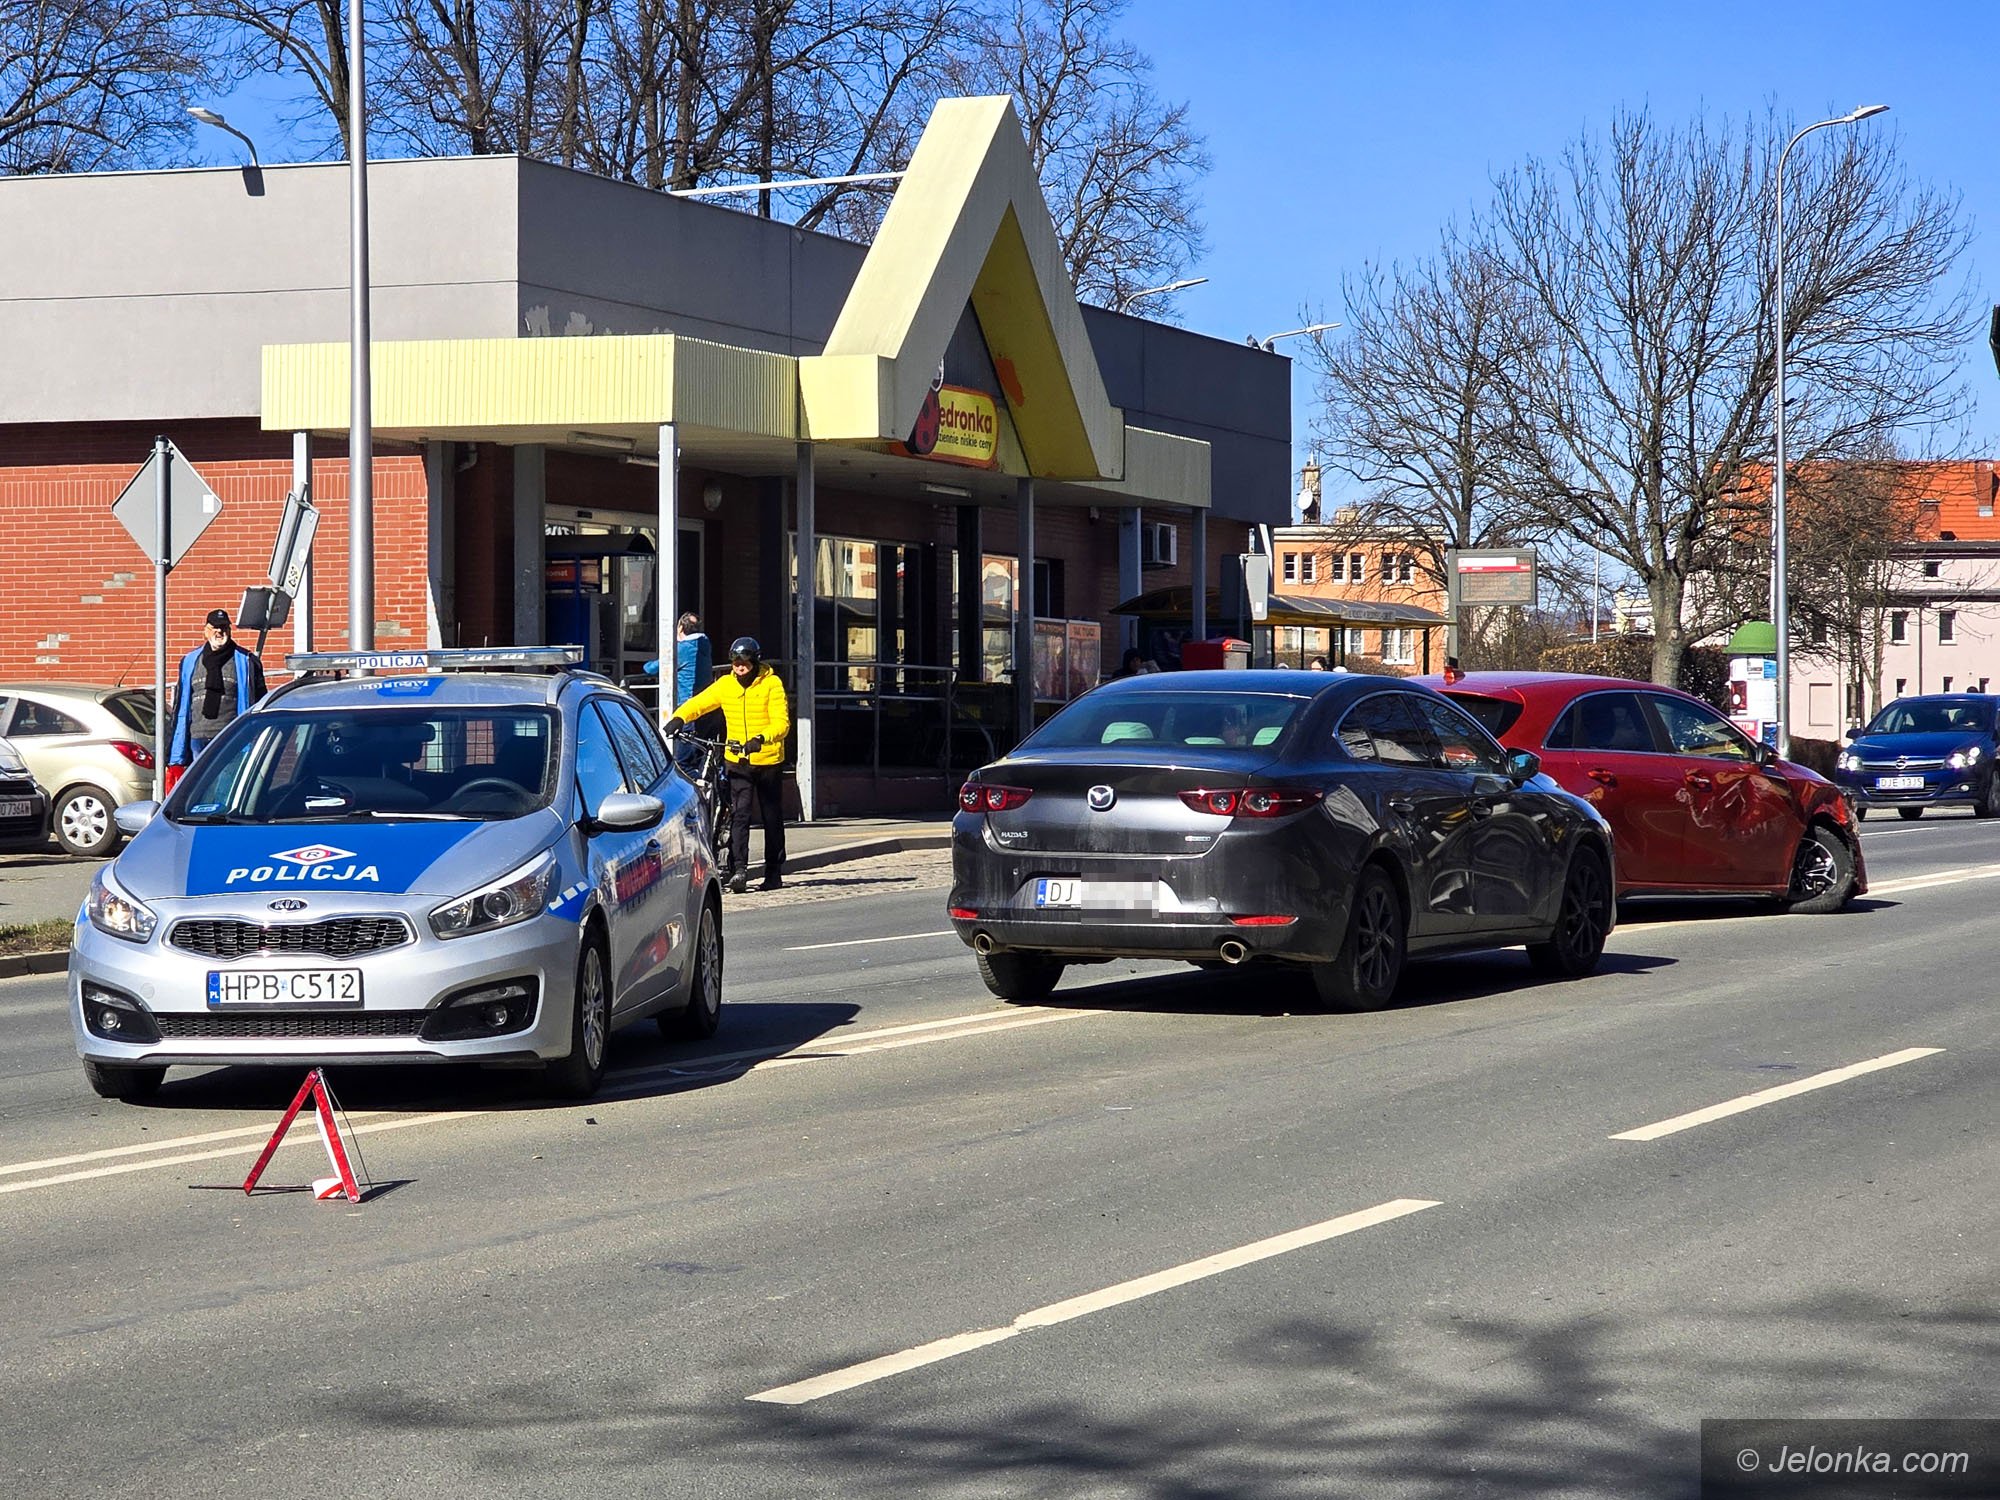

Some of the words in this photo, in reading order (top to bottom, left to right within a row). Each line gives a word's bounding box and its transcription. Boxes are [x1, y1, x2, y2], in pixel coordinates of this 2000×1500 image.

[939, 401, 993, 434] edronka
[358, 656, 426, 668] POLICJA
[225, 864, 380, 885] POLICJA
[1050, 882, 1074, 902] DJ
[209, 991, 219, 999] PL
[225, 975, 280, 1000] HPB
[291, 973, 355, 999] C512
